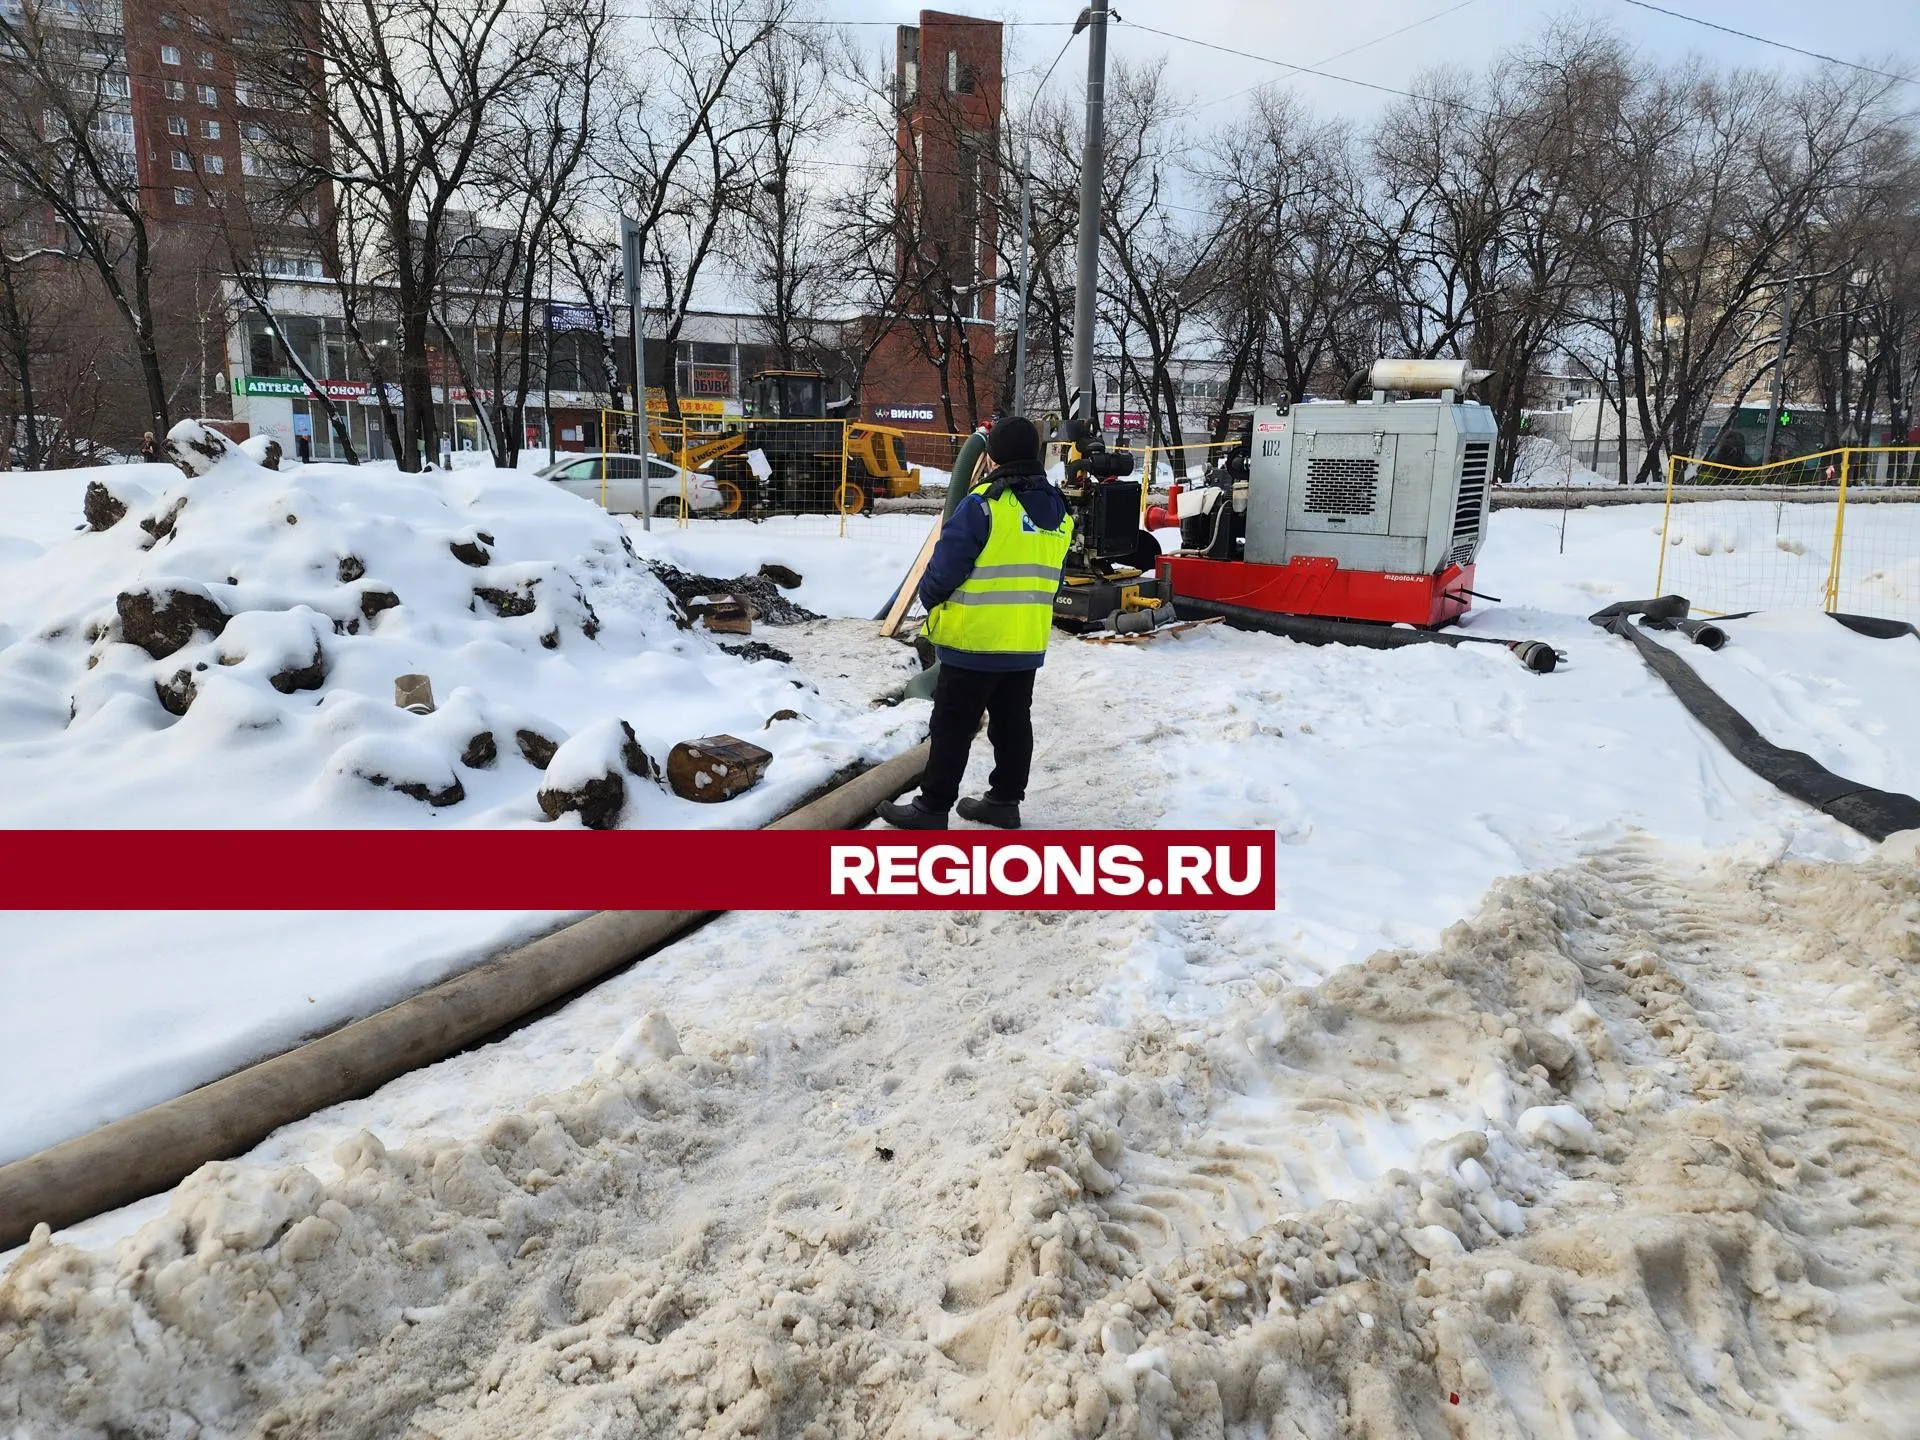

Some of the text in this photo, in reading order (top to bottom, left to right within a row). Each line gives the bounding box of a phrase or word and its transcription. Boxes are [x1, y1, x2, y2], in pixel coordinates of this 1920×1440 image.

[248, 382, 300, 393] АПТЕКА
[327, 385, 365, 396] ОНОМ
[693, 379, 730, 393] ОБУВИ
[695, 403, 714, 412] ВАС
[1262, 440, 1281, 457] 102
[1384, 574, 1424, 583] mzpotok.ru
